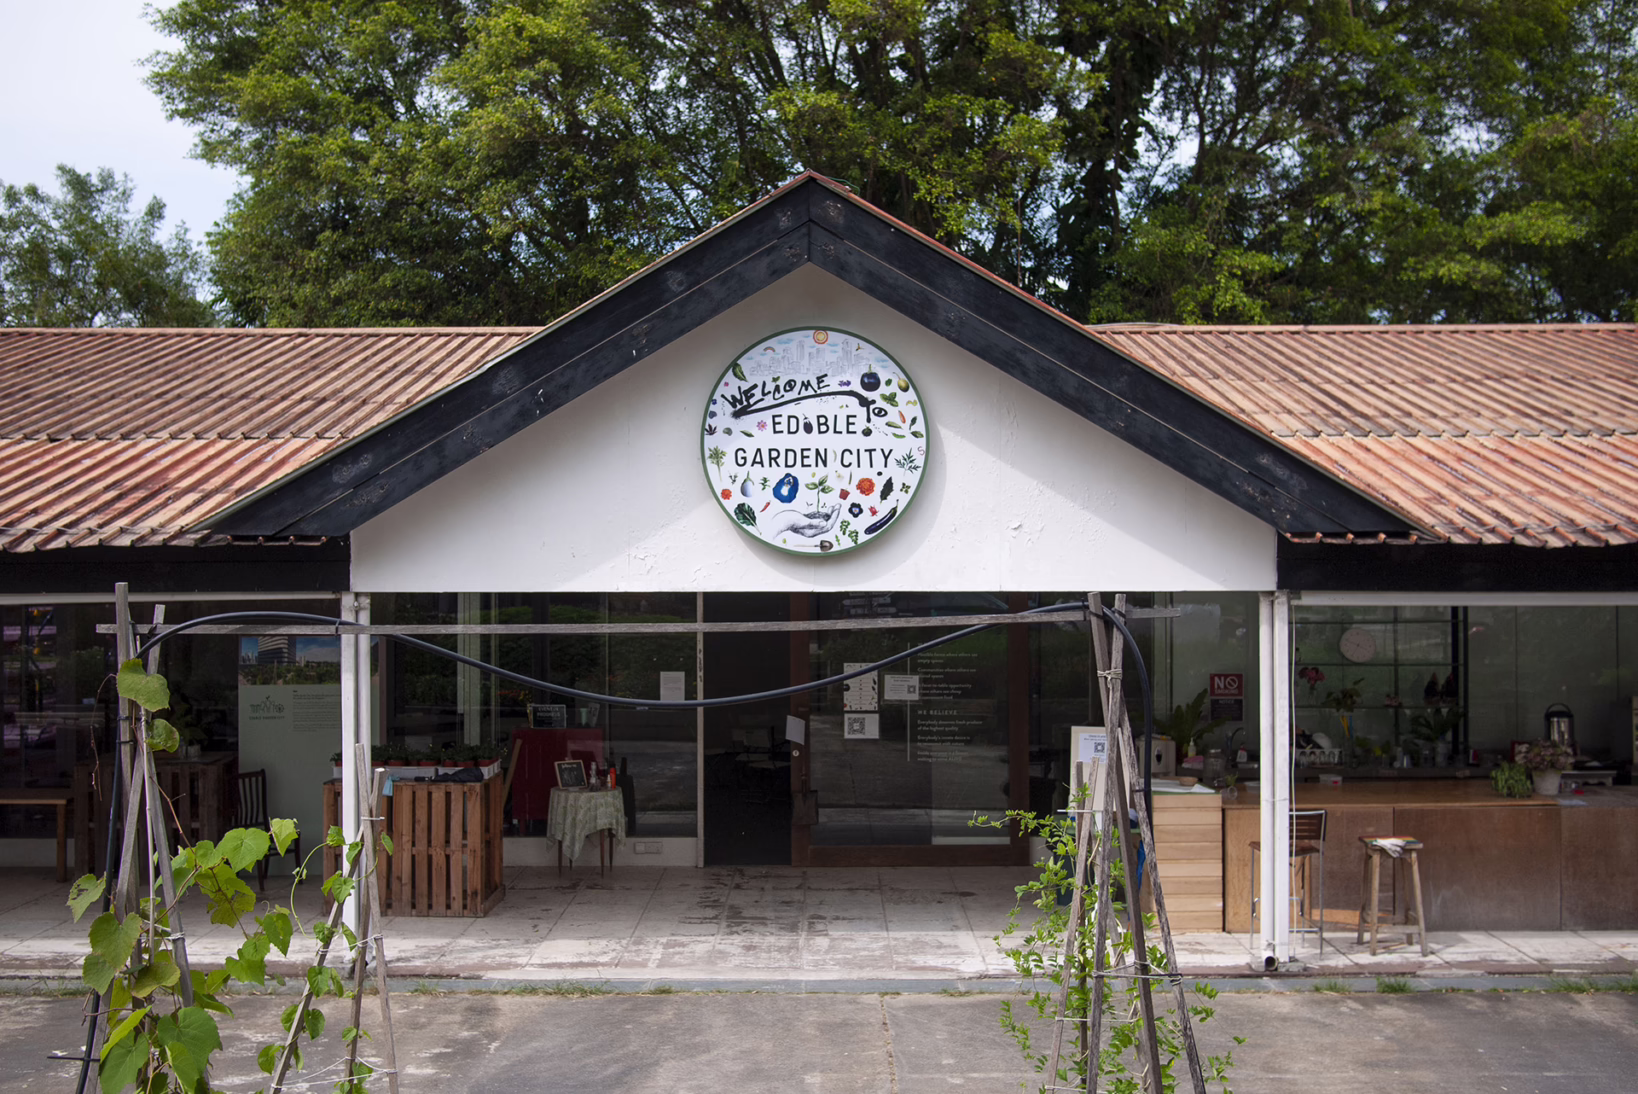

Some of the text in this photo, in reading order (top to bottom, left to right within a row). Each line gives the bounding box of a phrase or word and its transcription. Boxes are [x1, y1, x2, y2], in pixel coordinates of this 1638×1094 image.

[721, 373, 831, 409] WELCOME
[734, 447, 894, 468] GARDEN CITY
